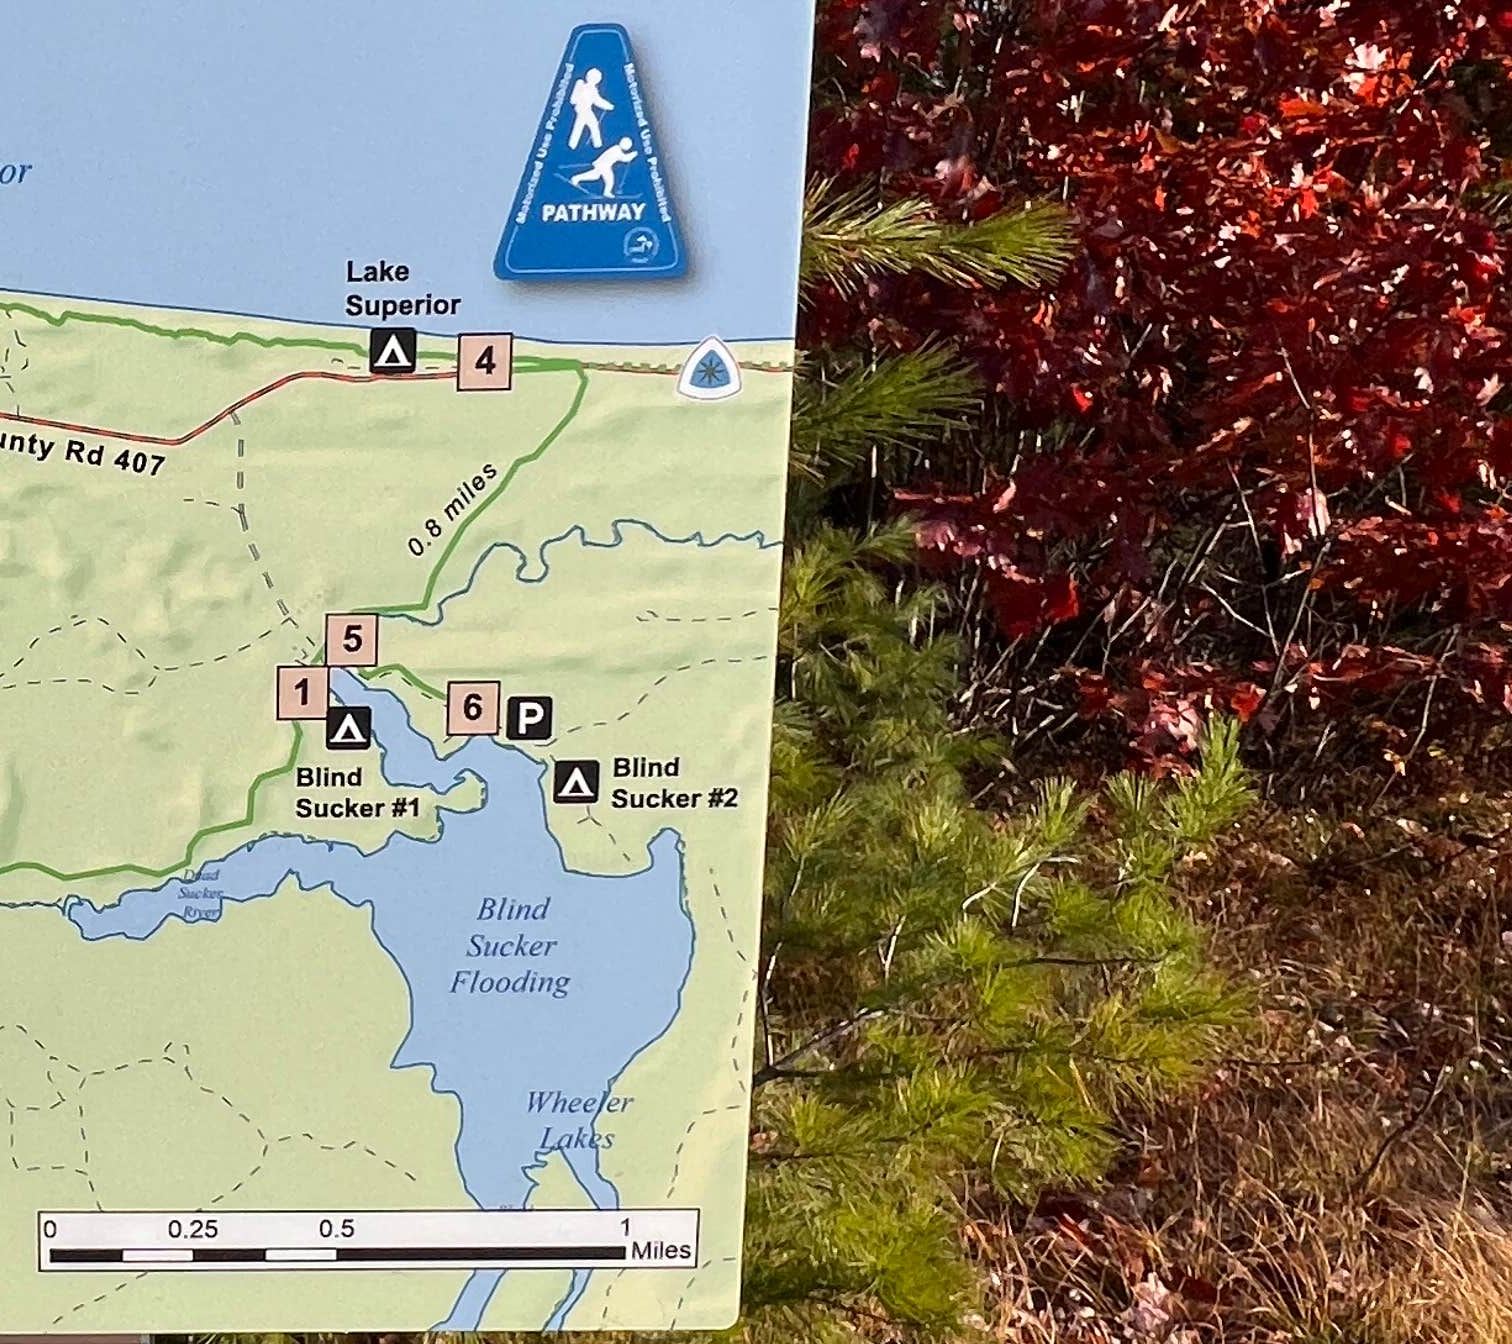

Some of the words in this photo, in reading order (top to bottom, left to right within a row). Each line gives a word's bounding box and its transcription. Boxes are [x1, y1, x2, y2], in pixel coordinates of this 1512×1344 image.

[516, 160, 544, 224] Motorized
[537, 132, 553, 158] Use
[545, 62, 574, 131] Prohibited
[624, 62, 648, 127] Motorized
[640, 128, 652, 155] Use
[647, 156, 671, 223] Prohibited
[542, 203, 646, 222] PATHWAY
[347, 260, 409, 282] Lake
[346, 293, 461, 321] Superior
[475, 345, 496, 374] 4
[65, 440, 104, 466] Rd
[115, 449, 166, 476] 407
[408, 519, 441, 556] 0.8
[444, 464, 497, 521] miles
[343, 624, 362, 652] 5
[295, 677, 309, 705] 1
[464, 693, 482, 721] 6
[297, 767, 362, 787] Blind
[613, 757, 680, 777] Blind
[296, 799, 384, 819] Sucker
[393, 798, 420, 817] #1
[611, 788, 702, 809] Sucker
[708, 787, 738, 808] #2
[178, 887, 223, 899] Sucker
[184, 906, 220, 917] River
[477, 896, 551, 921] Blind
[465, 933, 558, 957] Sucker
[449, 969, 571, 999] Flooding
[527, 1090, 635, 1114] Wheeler
[540, 1127, 616, 1150] Lakes
[43, 1220, 57, 1238] 0
[168, 1219, 218, 1238] 0.25
[319, 1219, 354, 1238] 0.5
[620, 1218, 630, 1236] 1
[632, 1241, 691, 1260] Miles
